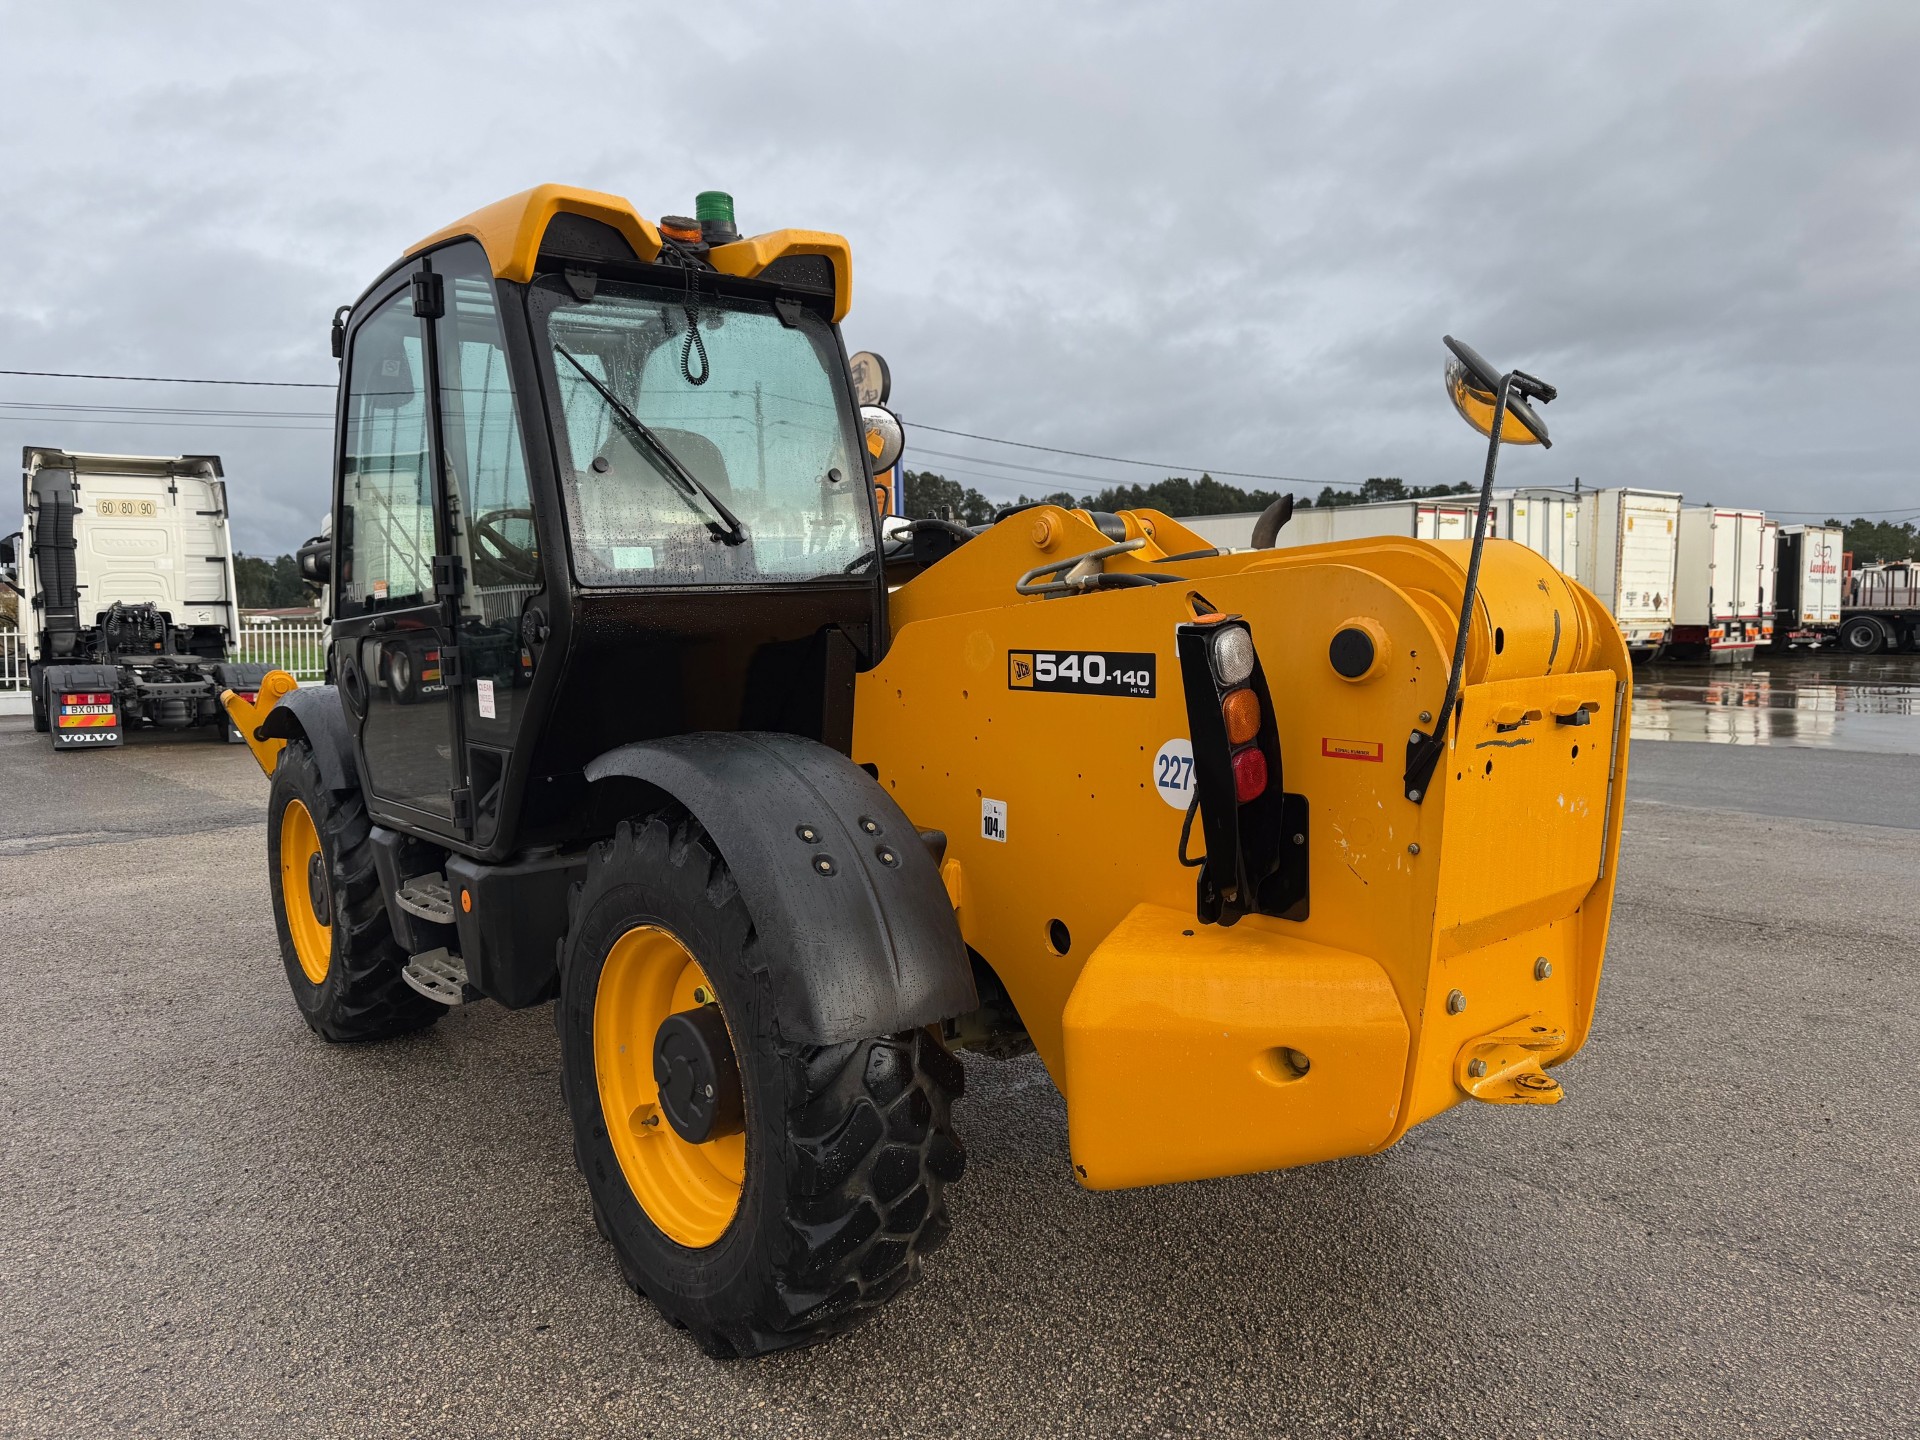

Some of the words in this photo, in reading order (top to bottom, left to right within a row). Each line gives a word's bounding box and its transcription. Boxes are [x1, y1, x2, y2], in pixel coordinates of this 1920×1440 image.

[102, 502, 113, 514] 60
[122, 503, 132, 514] 80
[141, 503, 151, 515] 90
[1016, 661, 1030, 677] JCB
[71, 706, 84, 714] BX
[96, 705, 108, 713] TN
[59, 733, 117, 742] VOLVO
[993, 806, 998, 814] L
[984, 815, 999, 838] 104
